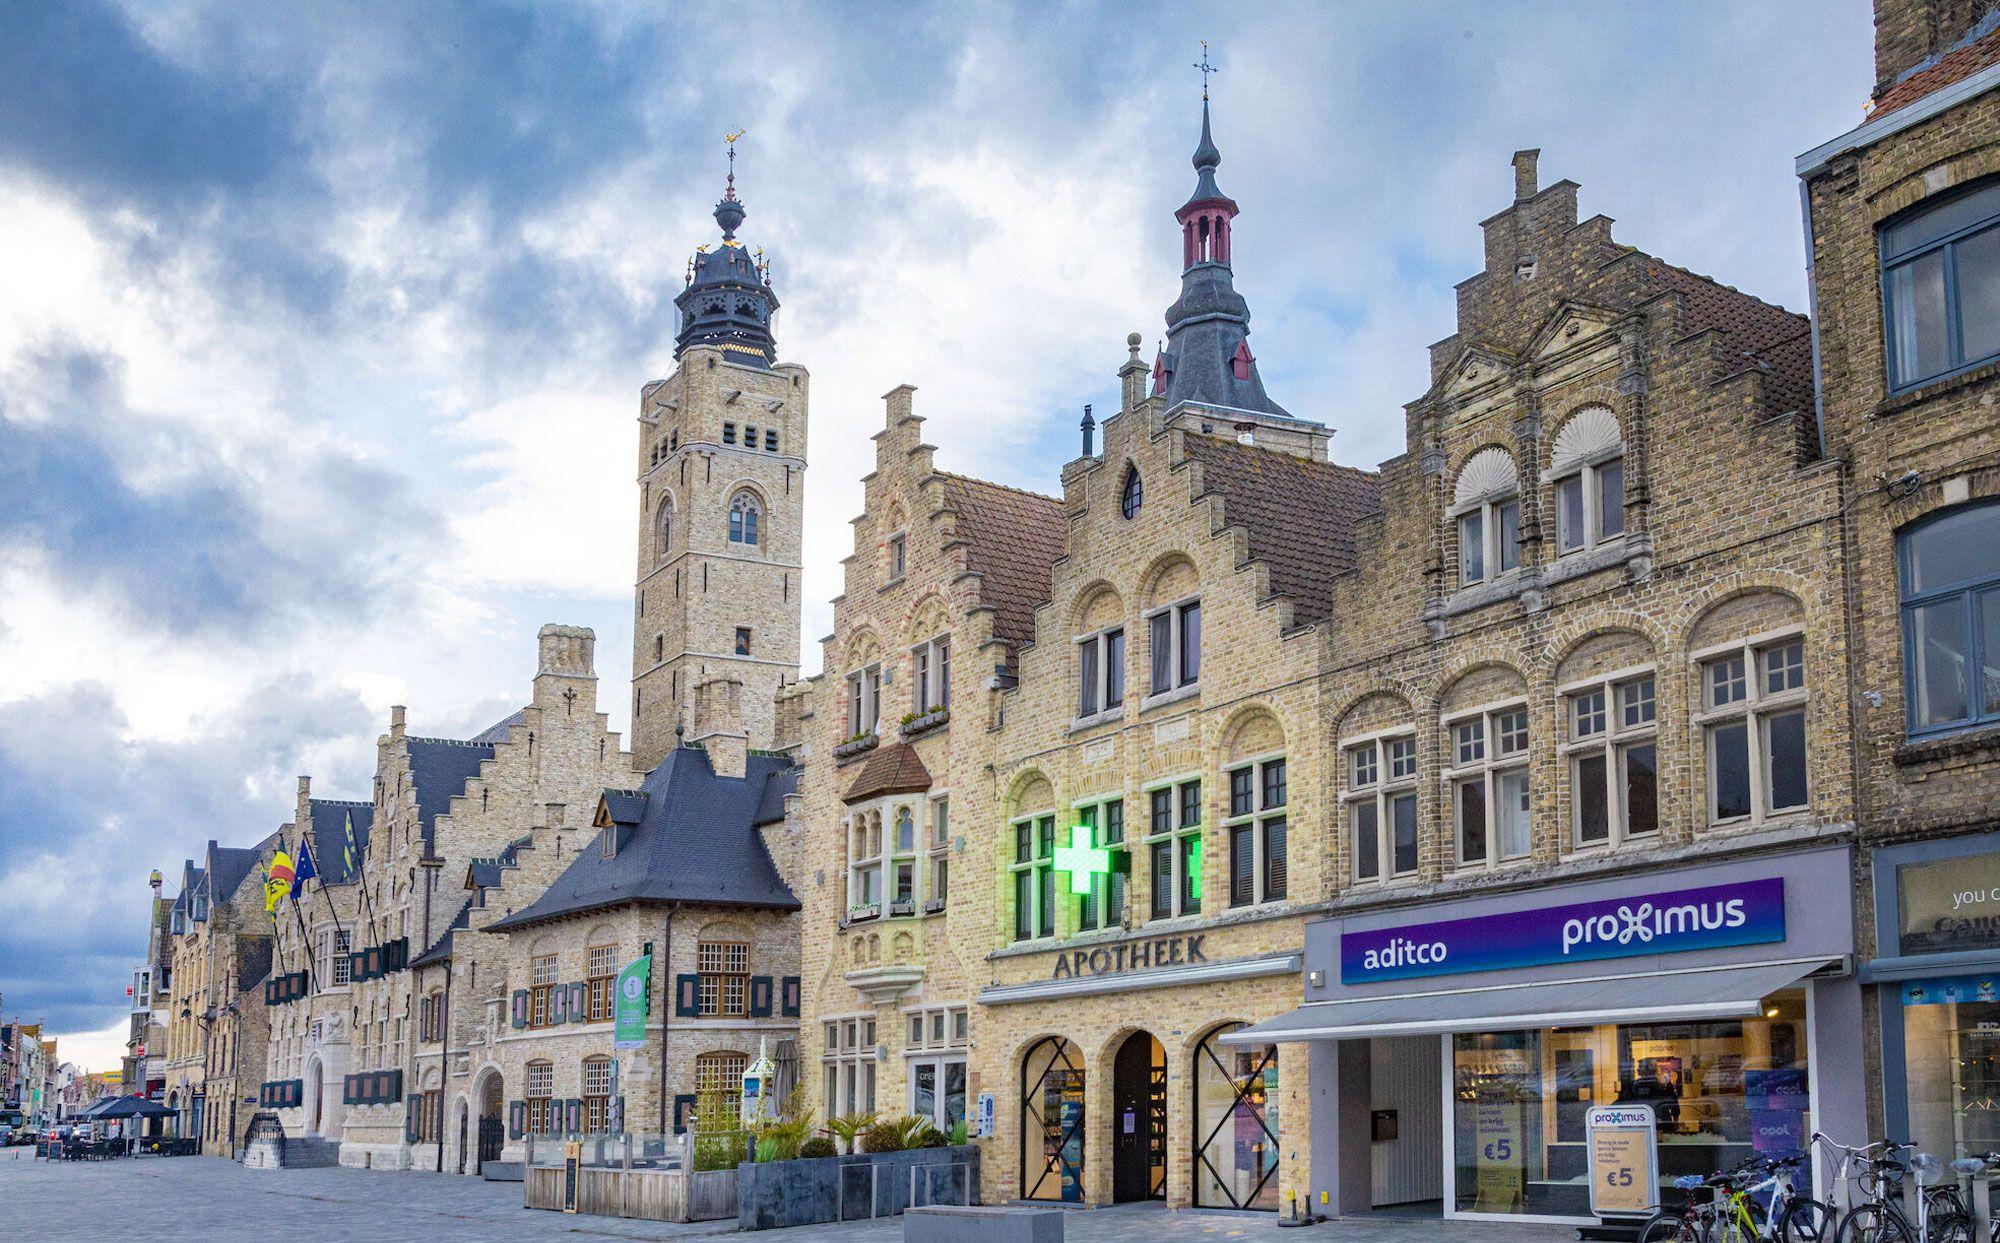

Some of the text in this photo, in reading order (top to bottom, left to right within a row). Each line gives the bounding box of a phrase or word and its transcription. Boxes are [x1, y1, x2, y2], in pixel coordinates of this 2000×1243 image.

[1953, 889, 1985, 910] you
[1562, 898, 1746, 955] proximus
[1052, 934, 1208, 979] APOTHEEK
[1363, 938, 1447, 970] aditco
[1595, 1112, 1646, 1125] proximus
